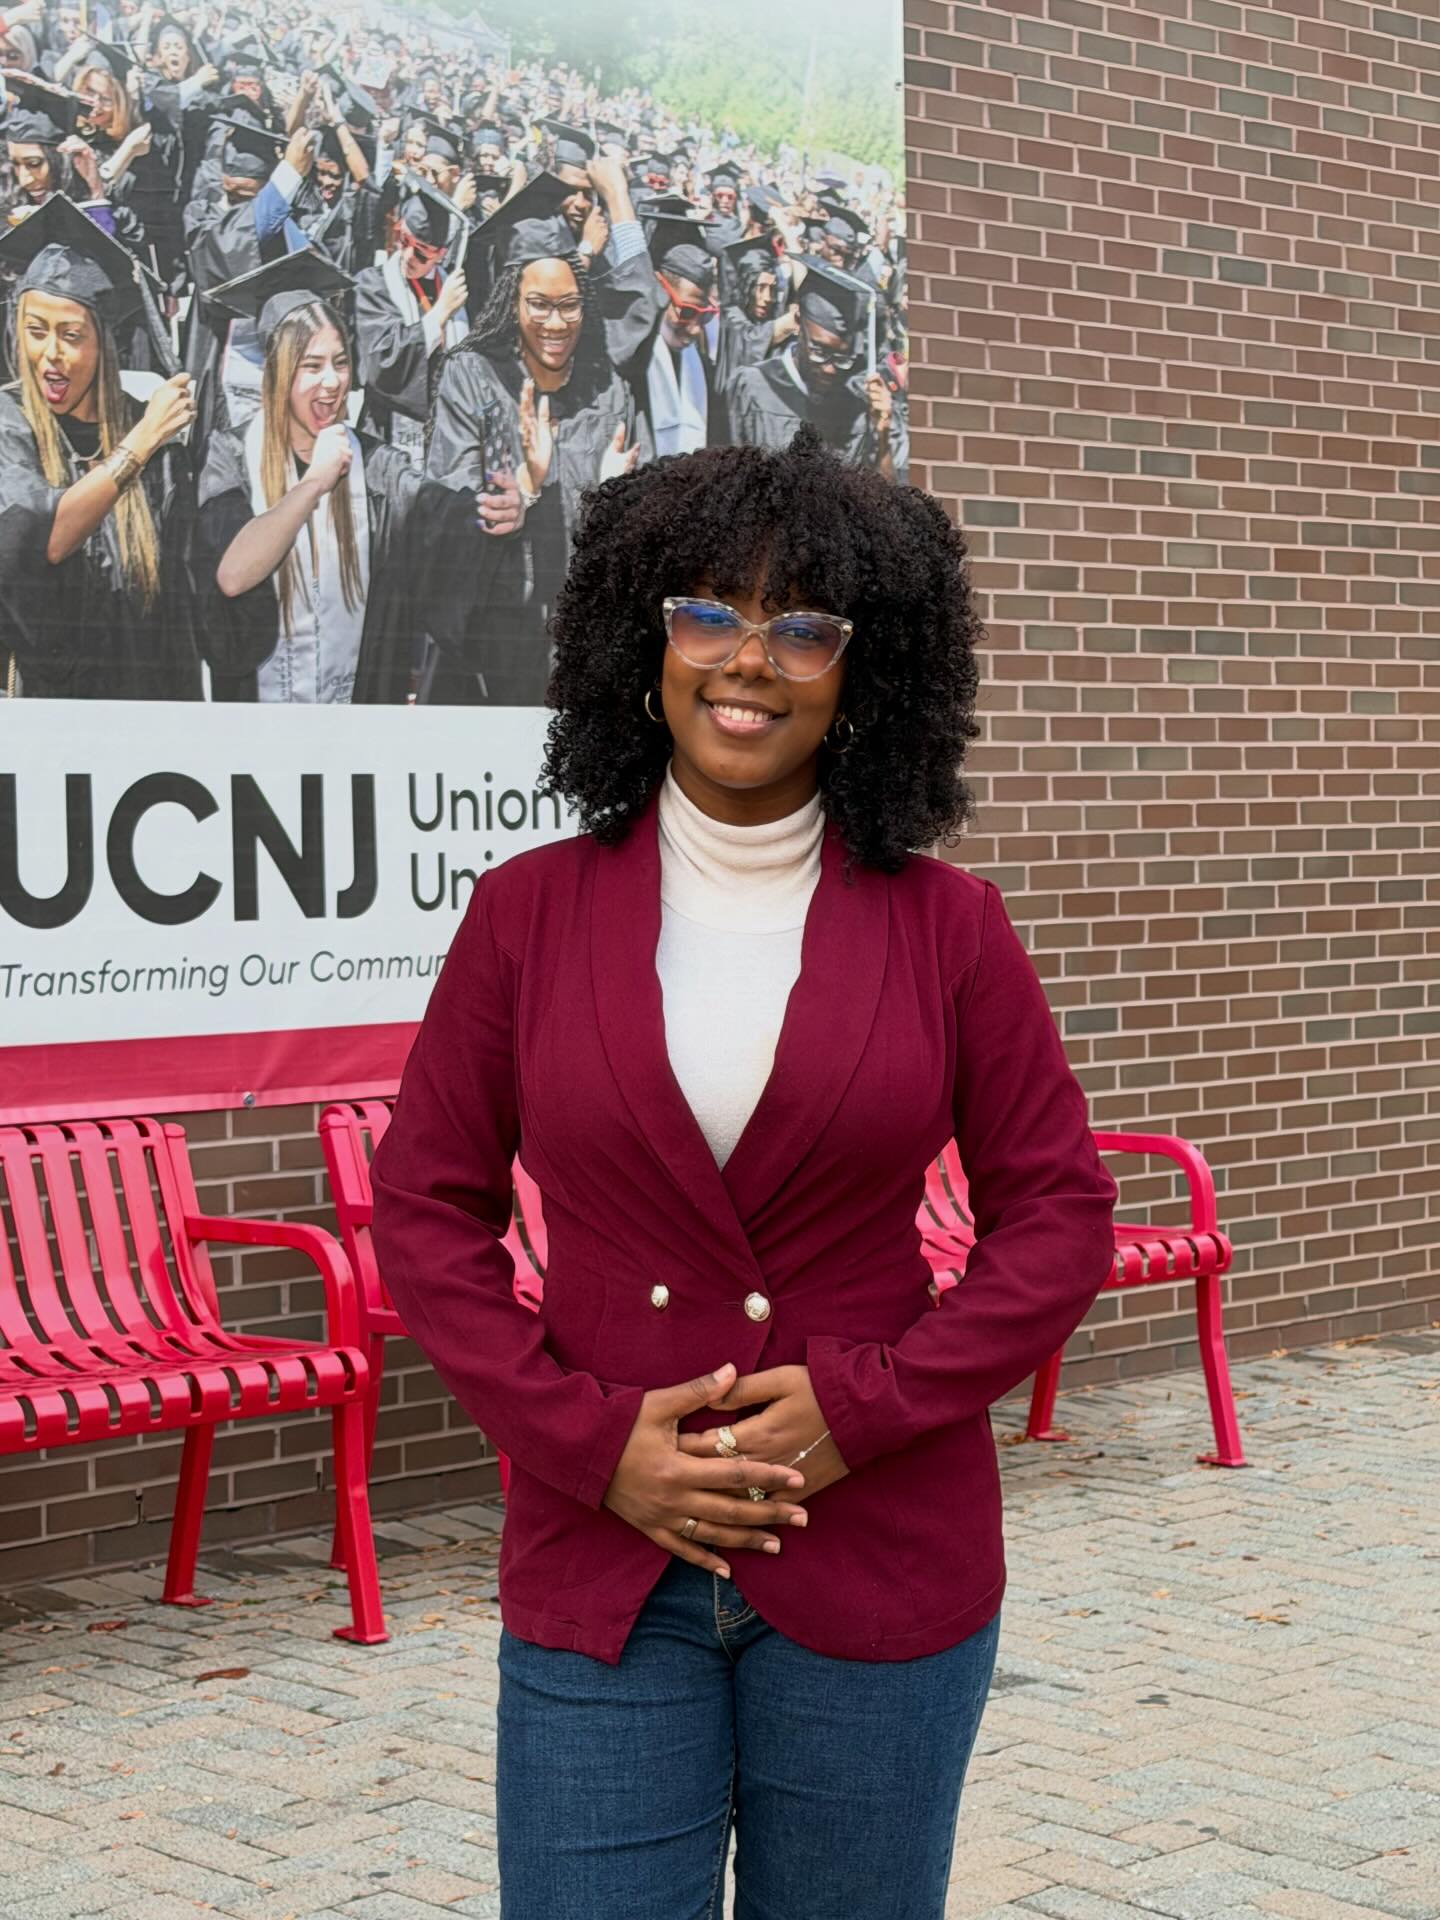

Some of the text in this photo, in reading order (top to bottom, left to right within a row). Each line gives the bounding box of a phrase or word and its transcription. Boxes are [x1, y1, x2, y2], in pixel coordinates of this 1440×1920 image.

[408, 771, 561, 832] Union
[0, 772, 379, 930] UCNJ
[411, 850, 493, 911] Un
[0, 961, 229, 997] Transforming
[240, 954, 300, 986] Our
